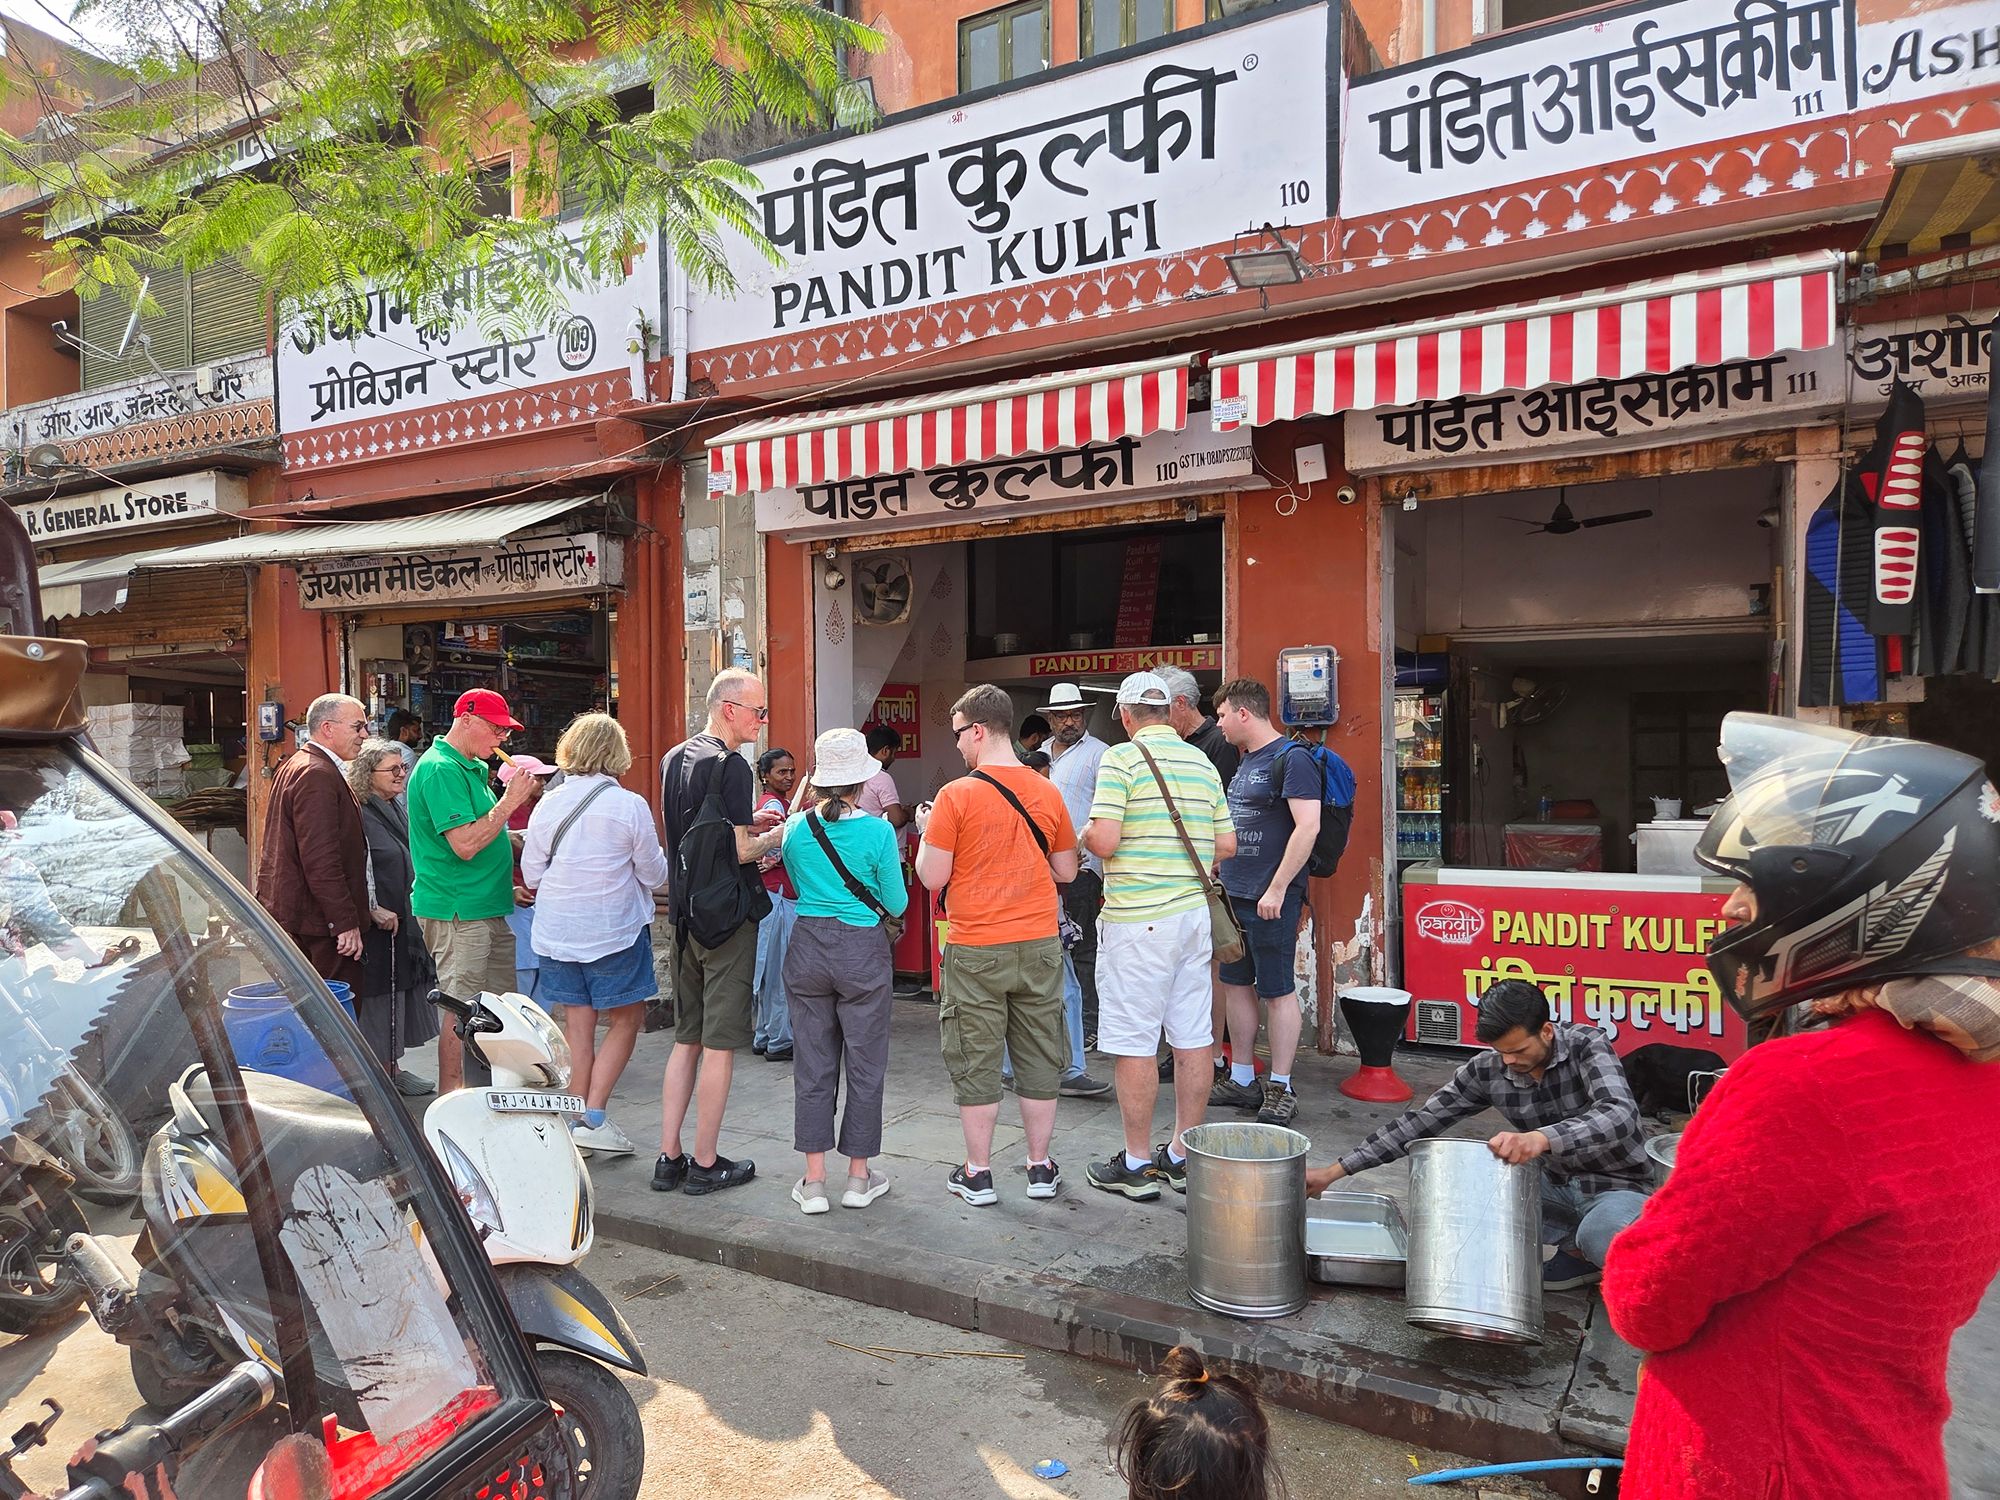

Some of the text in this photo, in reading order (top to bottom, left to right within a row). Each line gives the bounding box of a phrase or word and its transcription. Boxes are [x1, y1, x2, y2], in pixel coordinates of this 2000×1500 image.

[1367, 0, 1841, 174] पंडित आईसक्रीम
[1791, 89, 1825, 117] 111
[756, 152, 929, 256] पंडित
[938, 63, 1238, 234] कुल्फी
[1279, 180, 1310, 207] 110
[772, 199, 1163, 329] PANDIT KULFI
[565, 325, 590, 353] 109
[1846, 314, 1991, 381] अशो
[309, 359, 436, 422] प्रोविजन
[1786, 370, 1818, 395] 111
[1155, 461, 1178, 482] 110
[43, 503, 121, 533] GENERAL
[124, 491, 188, 521] STORE
[795, 472, 916, 520] पडित
[301, 566, 382, 601] जयराम
[552, 538, 588, 580] स्टोर
[1035, 650, 1217, 674] PANDIT KULFI
[466, 701, 475, 712] 3
[877, 690, 917, 726] कुल्फी
[1420, 910, 1480, 935] pandit
[1442, 931, 1470, 943] kulfi
[1492, 910, 1612, 948] PANDIT
[1581, 967, 1723, 1041] कुल्फी
